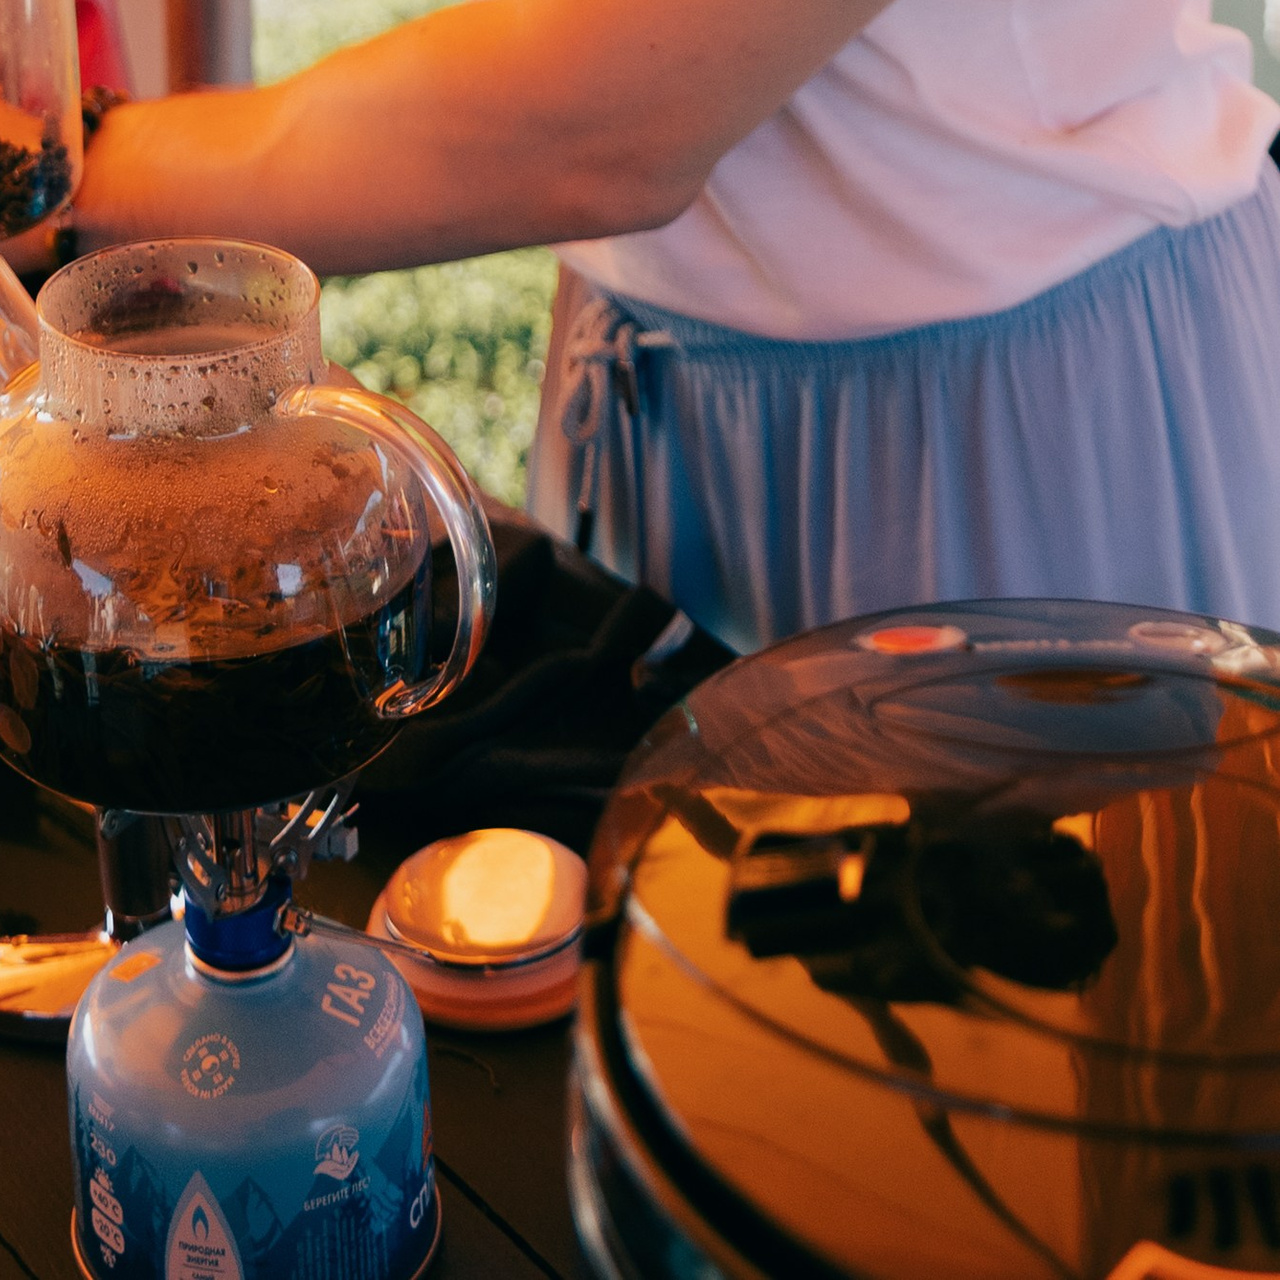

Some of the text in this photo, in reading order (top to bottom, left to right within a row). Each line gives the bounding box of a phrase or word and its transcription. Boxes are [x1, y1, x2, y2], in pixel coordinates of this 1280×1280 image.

[321, 962, 376, 1028] ГАЗ
[90, 1131, 117, 1167] 230
[303, 1185, 350, 1212] БЕРЕГИТЕ
[178, 1240, 226, 1257] ПРИРОДНАЯ
